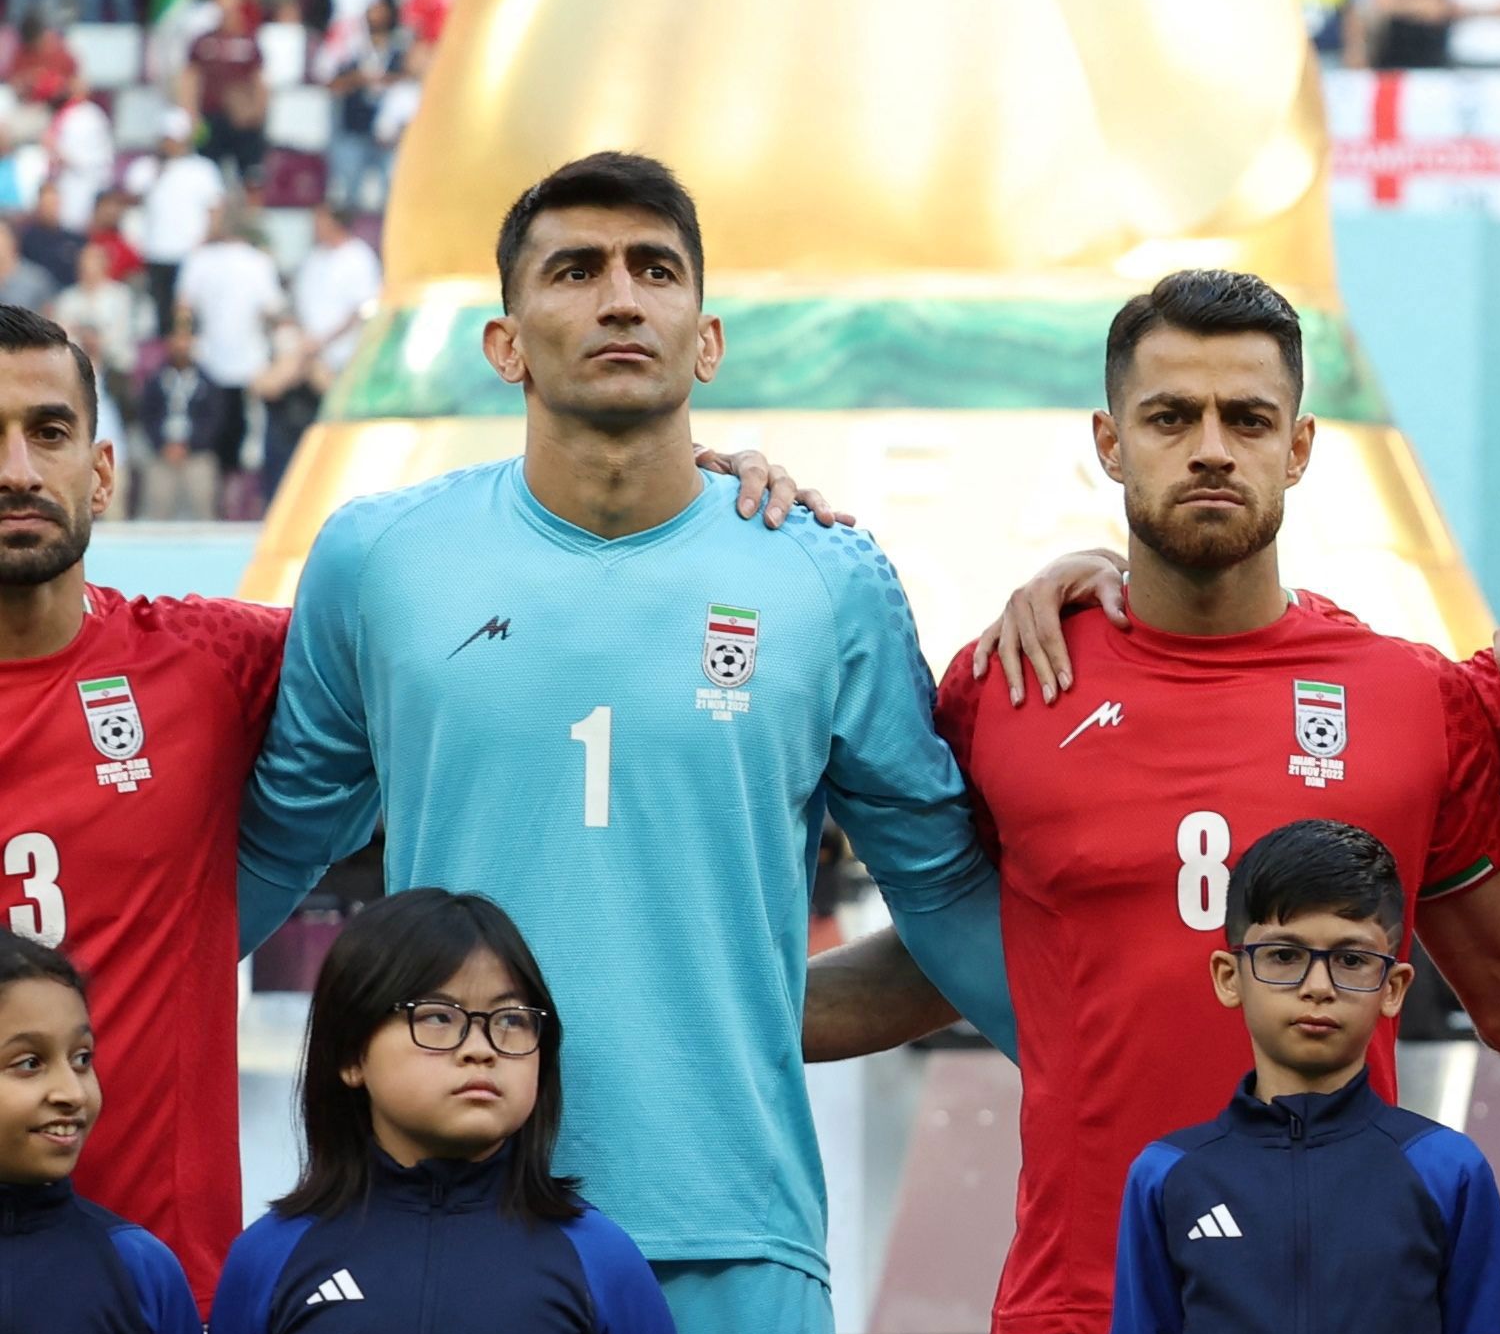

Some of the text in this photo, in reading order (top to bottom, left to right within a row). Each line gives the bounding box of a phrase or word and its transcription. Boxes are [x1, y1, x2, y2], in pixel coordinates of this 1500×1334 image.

[570, 705, 612, 827] 1
[3, 832, 67, 948] 3
[1176, 810, 1231, 931] 8
